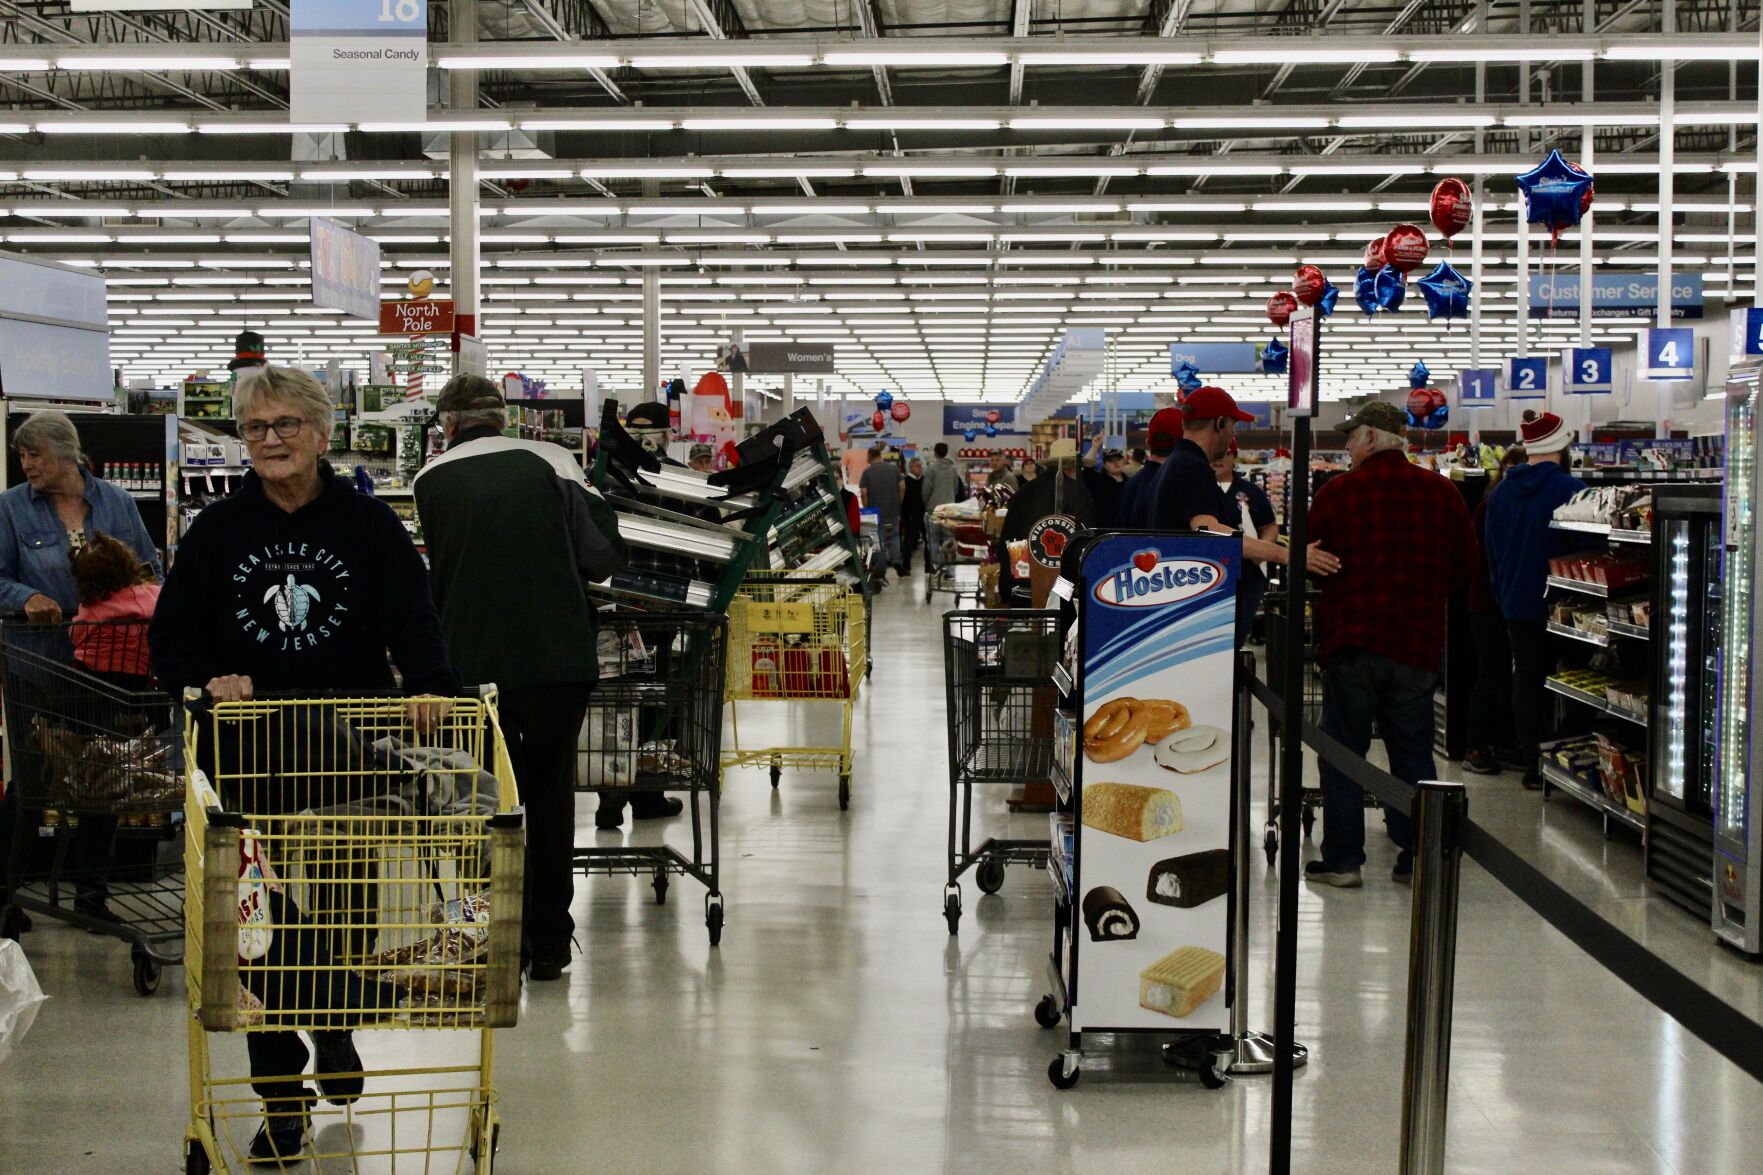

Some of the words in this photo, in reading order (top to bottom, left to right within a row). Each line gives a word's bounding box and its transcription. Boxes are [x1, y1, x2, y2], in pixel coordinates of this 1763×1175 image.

[333, 49, 382, 60] Seasonal
[384, 49, 420, 61] Candy
[1539, 283, 1624, 300] Custmer
[1628, 283, 1693, 299] Serce
[395, 303, 440, 317] North
[1591, 309, 1630, 318] xchanges
[1637, 308, 1651, 316] Gift
[403, 317, 433, 332] Pole
[787, 352, 832, 362] Women's
[1175, 353, 1196, 363] Dog
[1658, 340, 1679, 367] 4
[1519, 369, 1535, 389] 2
[1581, 359, 1599, 383] 3
[1470, 378, 1481, 398] 1
[952, 420, 985, 431] Engine
[1031, 519, 1076, 541] WISCONSIN
[233, 554, 261, 583] SEA
[264, 542, 308, 559] ISLE
[315, 548, 350, 579] CITY
[1041, 557, 1061, 567] BES
[1114, 565, 1215, 604] Hostess
[236, 607, 271, 643] NEW
[281, 603, 349, 651] JERSEY
